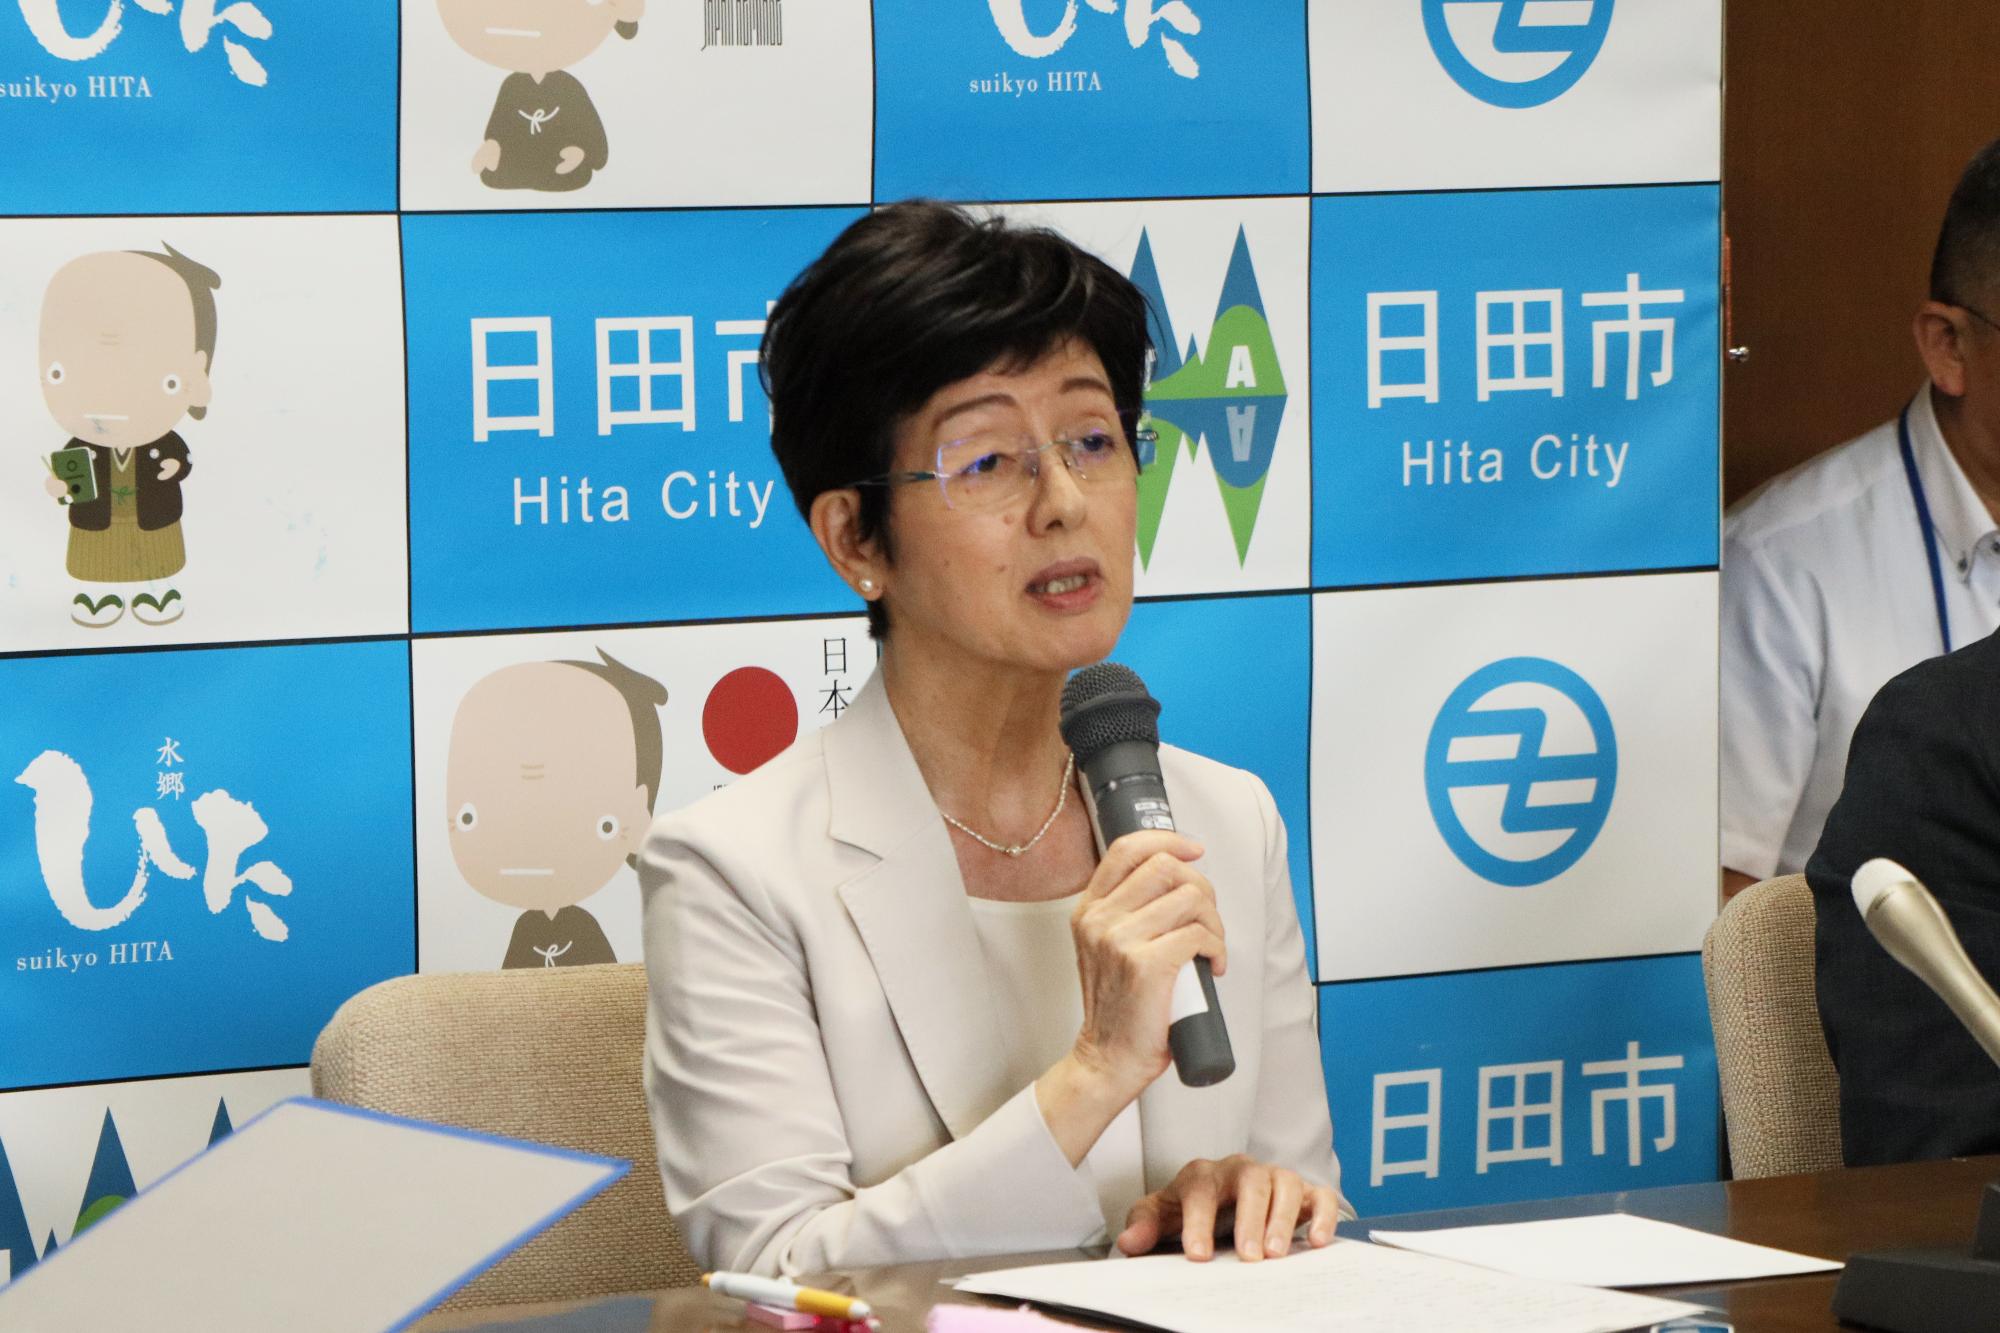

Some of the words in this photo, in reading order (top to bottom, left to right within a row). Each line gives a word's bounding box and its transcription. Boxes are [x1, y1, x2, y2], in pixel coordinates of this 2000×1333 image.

[88, 76, 152, 97] HITA
[970, 72, 1038, 98] suikyo
[1048, 71, 1102, 91] HITA
[1366, 272, 1686, 409] 日田市
[1403, 439, 1503, 486] Hita
[1530, 434, 1630, 488] City
[513, 476, 630, 526] Hita
[660, 470, 775, 529] City
[156, 737, 185, 800] 水郷
[14, 749, 293, 943] ひた
[17, 948, 98, 972] suikyo
[110, 941, 174, 965] HITA
[1370, 1041, 1684, 1187] 日田市
